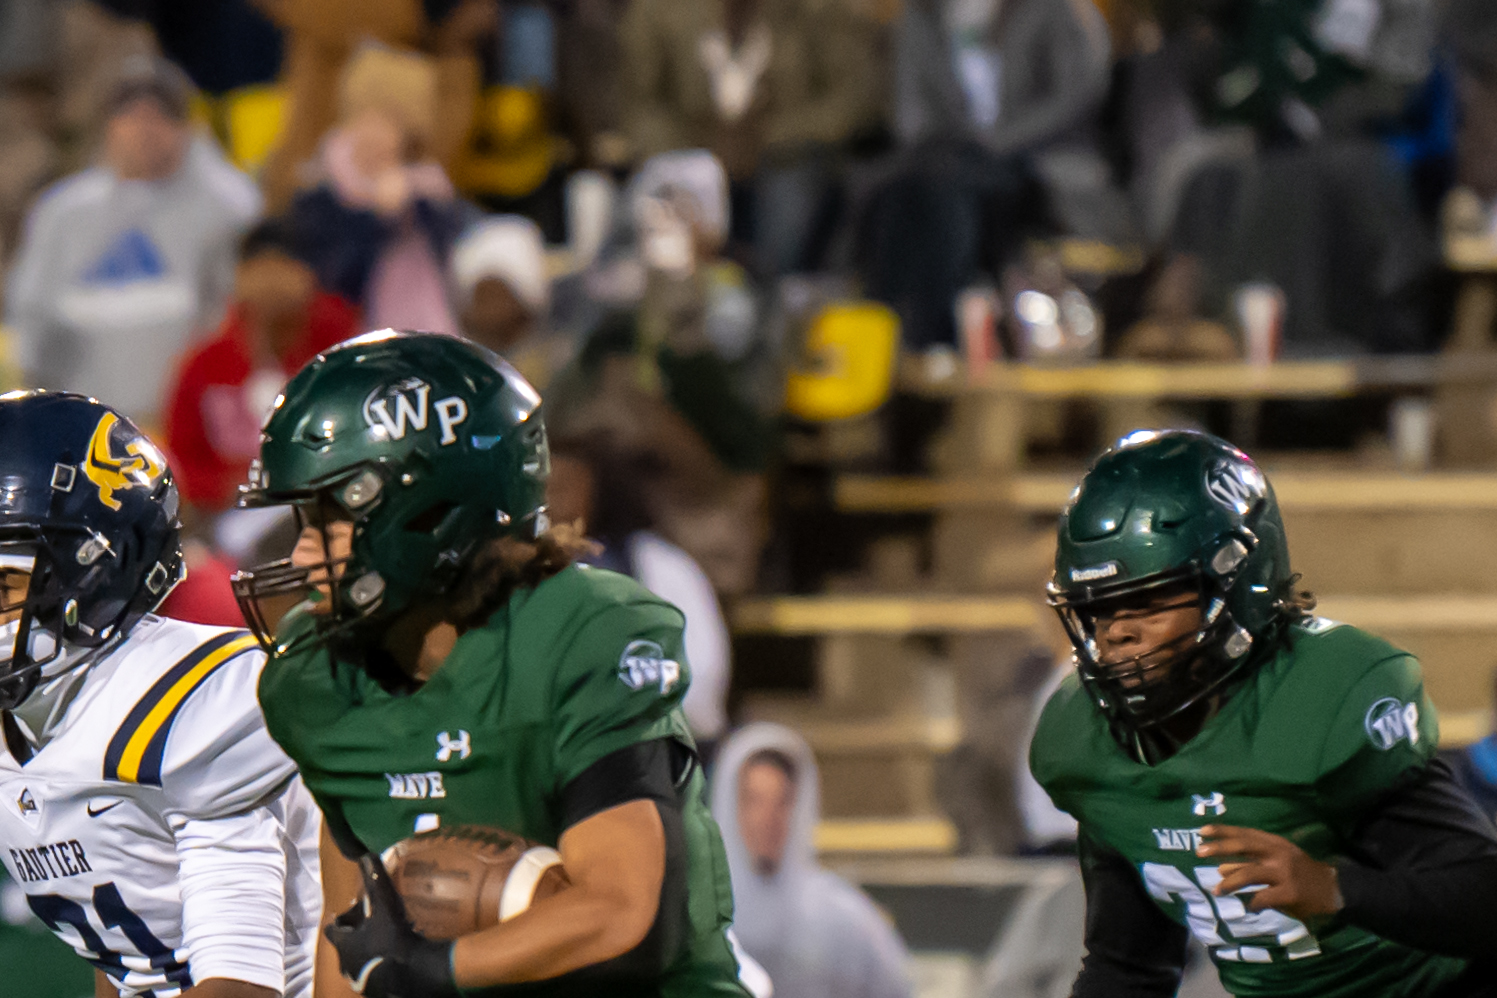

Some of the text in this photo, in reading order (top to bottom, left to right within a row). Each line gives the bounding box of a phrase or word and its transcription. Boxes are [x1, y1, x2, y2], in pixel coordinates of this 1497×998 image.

[369, 382, 468, 446] WP
[384, 771, 446, 799] WAVE
[8, 838, 94, 882] GAUTIER
